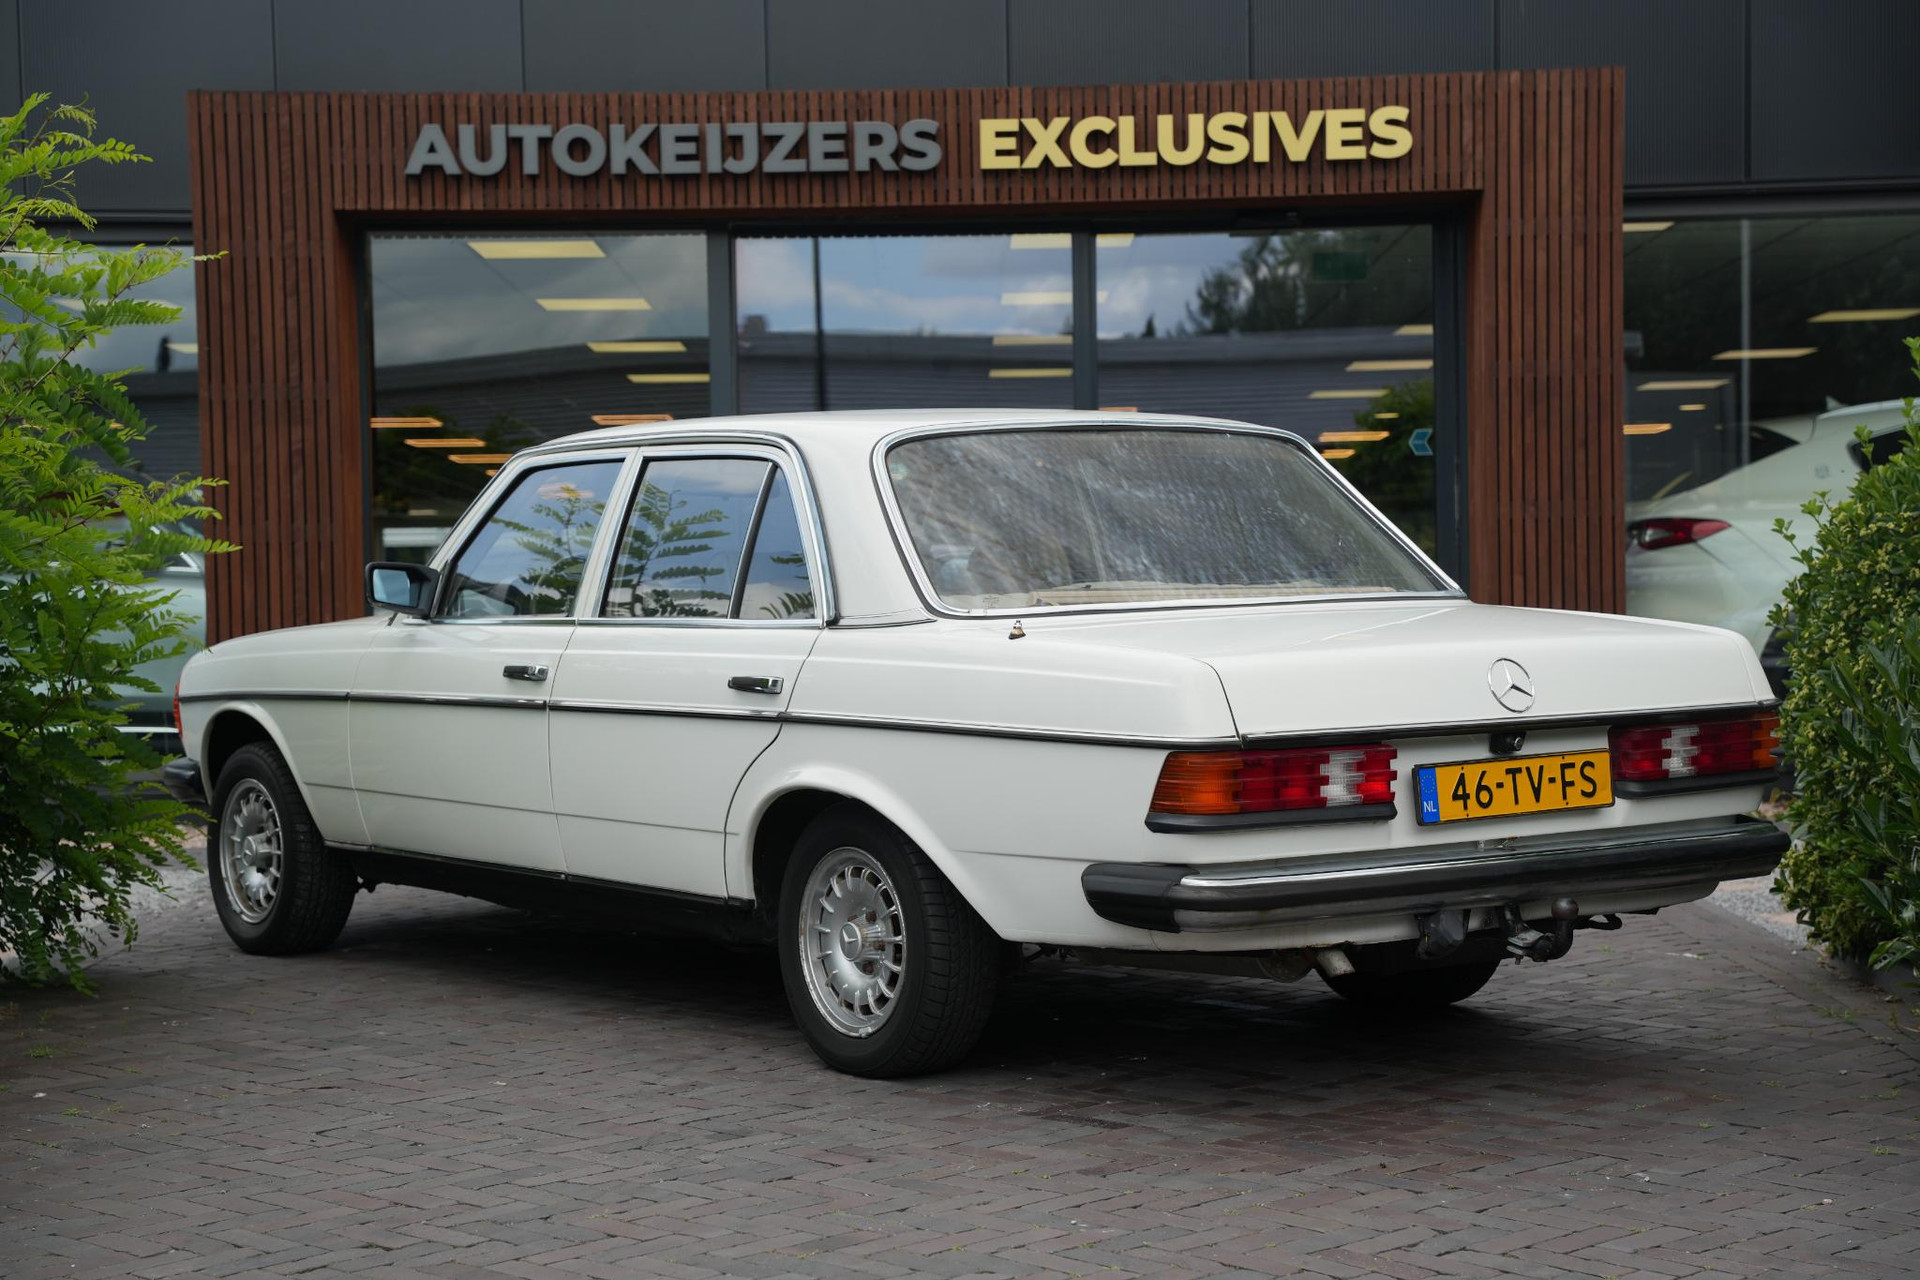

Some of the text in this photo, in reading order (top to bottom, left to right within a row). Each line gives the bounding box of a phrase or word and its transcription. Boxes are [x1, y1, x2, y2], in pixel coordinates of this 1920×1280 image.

[405, 105, 1413, 176] AUTOKEIJZERS EXCLUSIVES
[1423, 760, 1598, 813] NL 46-TV-FS
